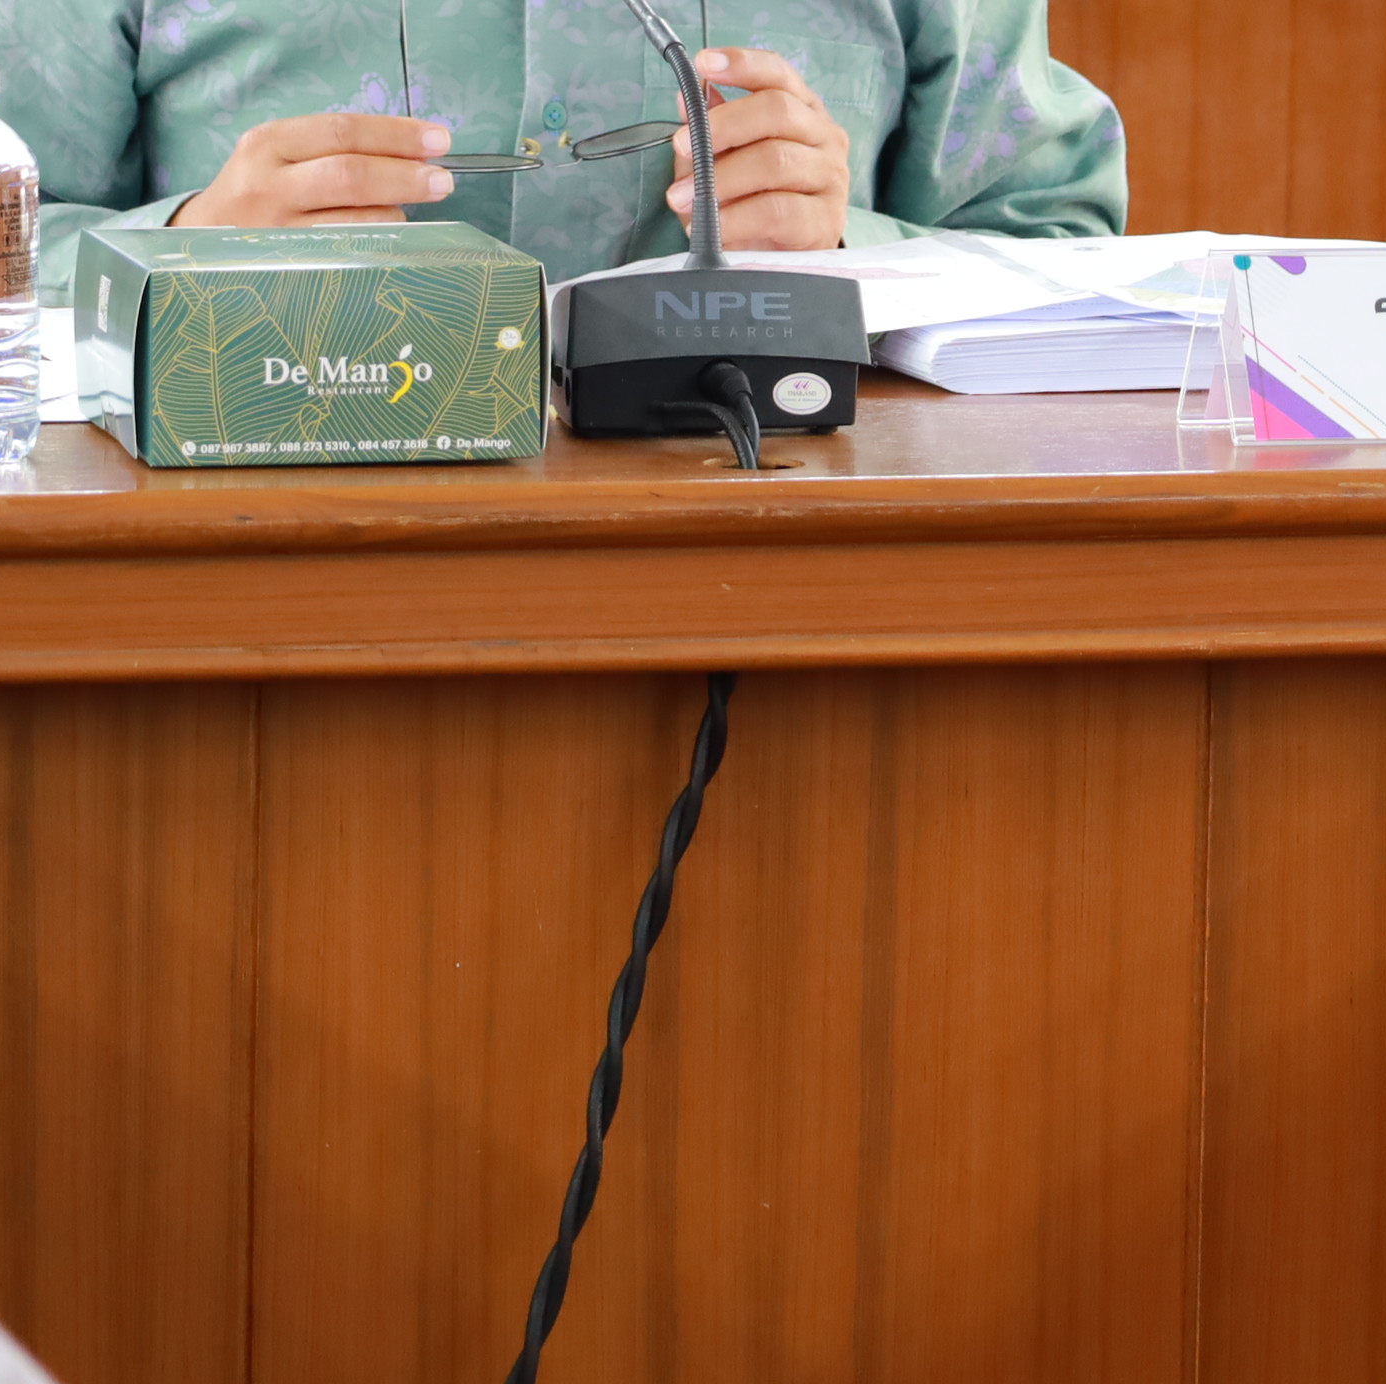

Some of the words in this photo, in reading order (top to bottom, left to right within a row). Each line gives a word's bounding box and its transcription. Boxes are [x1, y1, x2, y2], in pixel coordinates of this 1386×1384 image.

[655, 291, 791, 320] NPE
[656, 326, 793, 338] RESEARCH
[262, 357, 308, 385] De
[307, 385, 389, 396] Restaurant
[200, 444, 221, 454] 087
[279, 442, 301, 452] 088
[302, 441, 323, 452] 273
[358, 440, 379, 451] 084
[380, 439, 401, 450] 457
[456, 438, 472, 448] De
[473, 438, 512, 450] Mango
